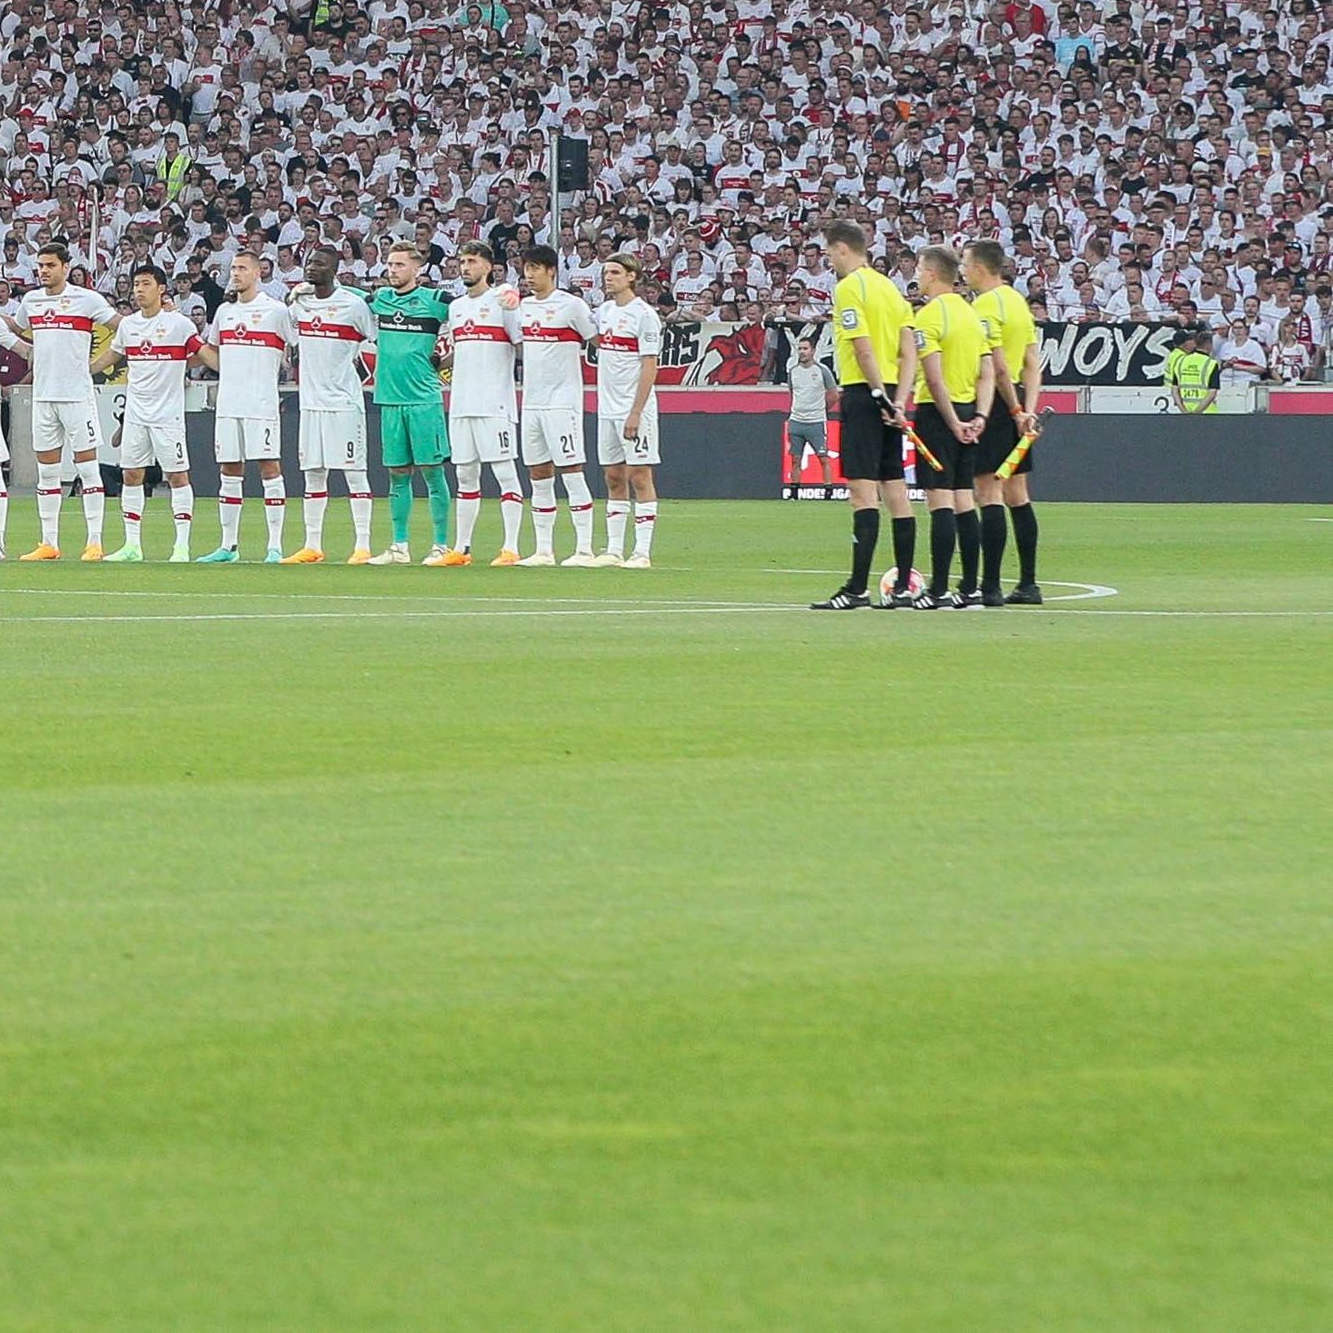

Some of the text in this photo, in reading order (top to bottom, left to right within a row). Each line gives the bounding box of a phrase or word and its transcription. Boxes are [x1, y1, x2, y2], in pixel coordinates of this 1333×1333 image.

[87, 420, 95, 437] 5
[264, 428, 271, 446] 2
[498, 431, 509, 448] 16
[560, 435, 575, 453] 21
[632, 436, 648, 453] 24
[176, 442, 183, 459] 3
[347, 441, 354, 459] 9
